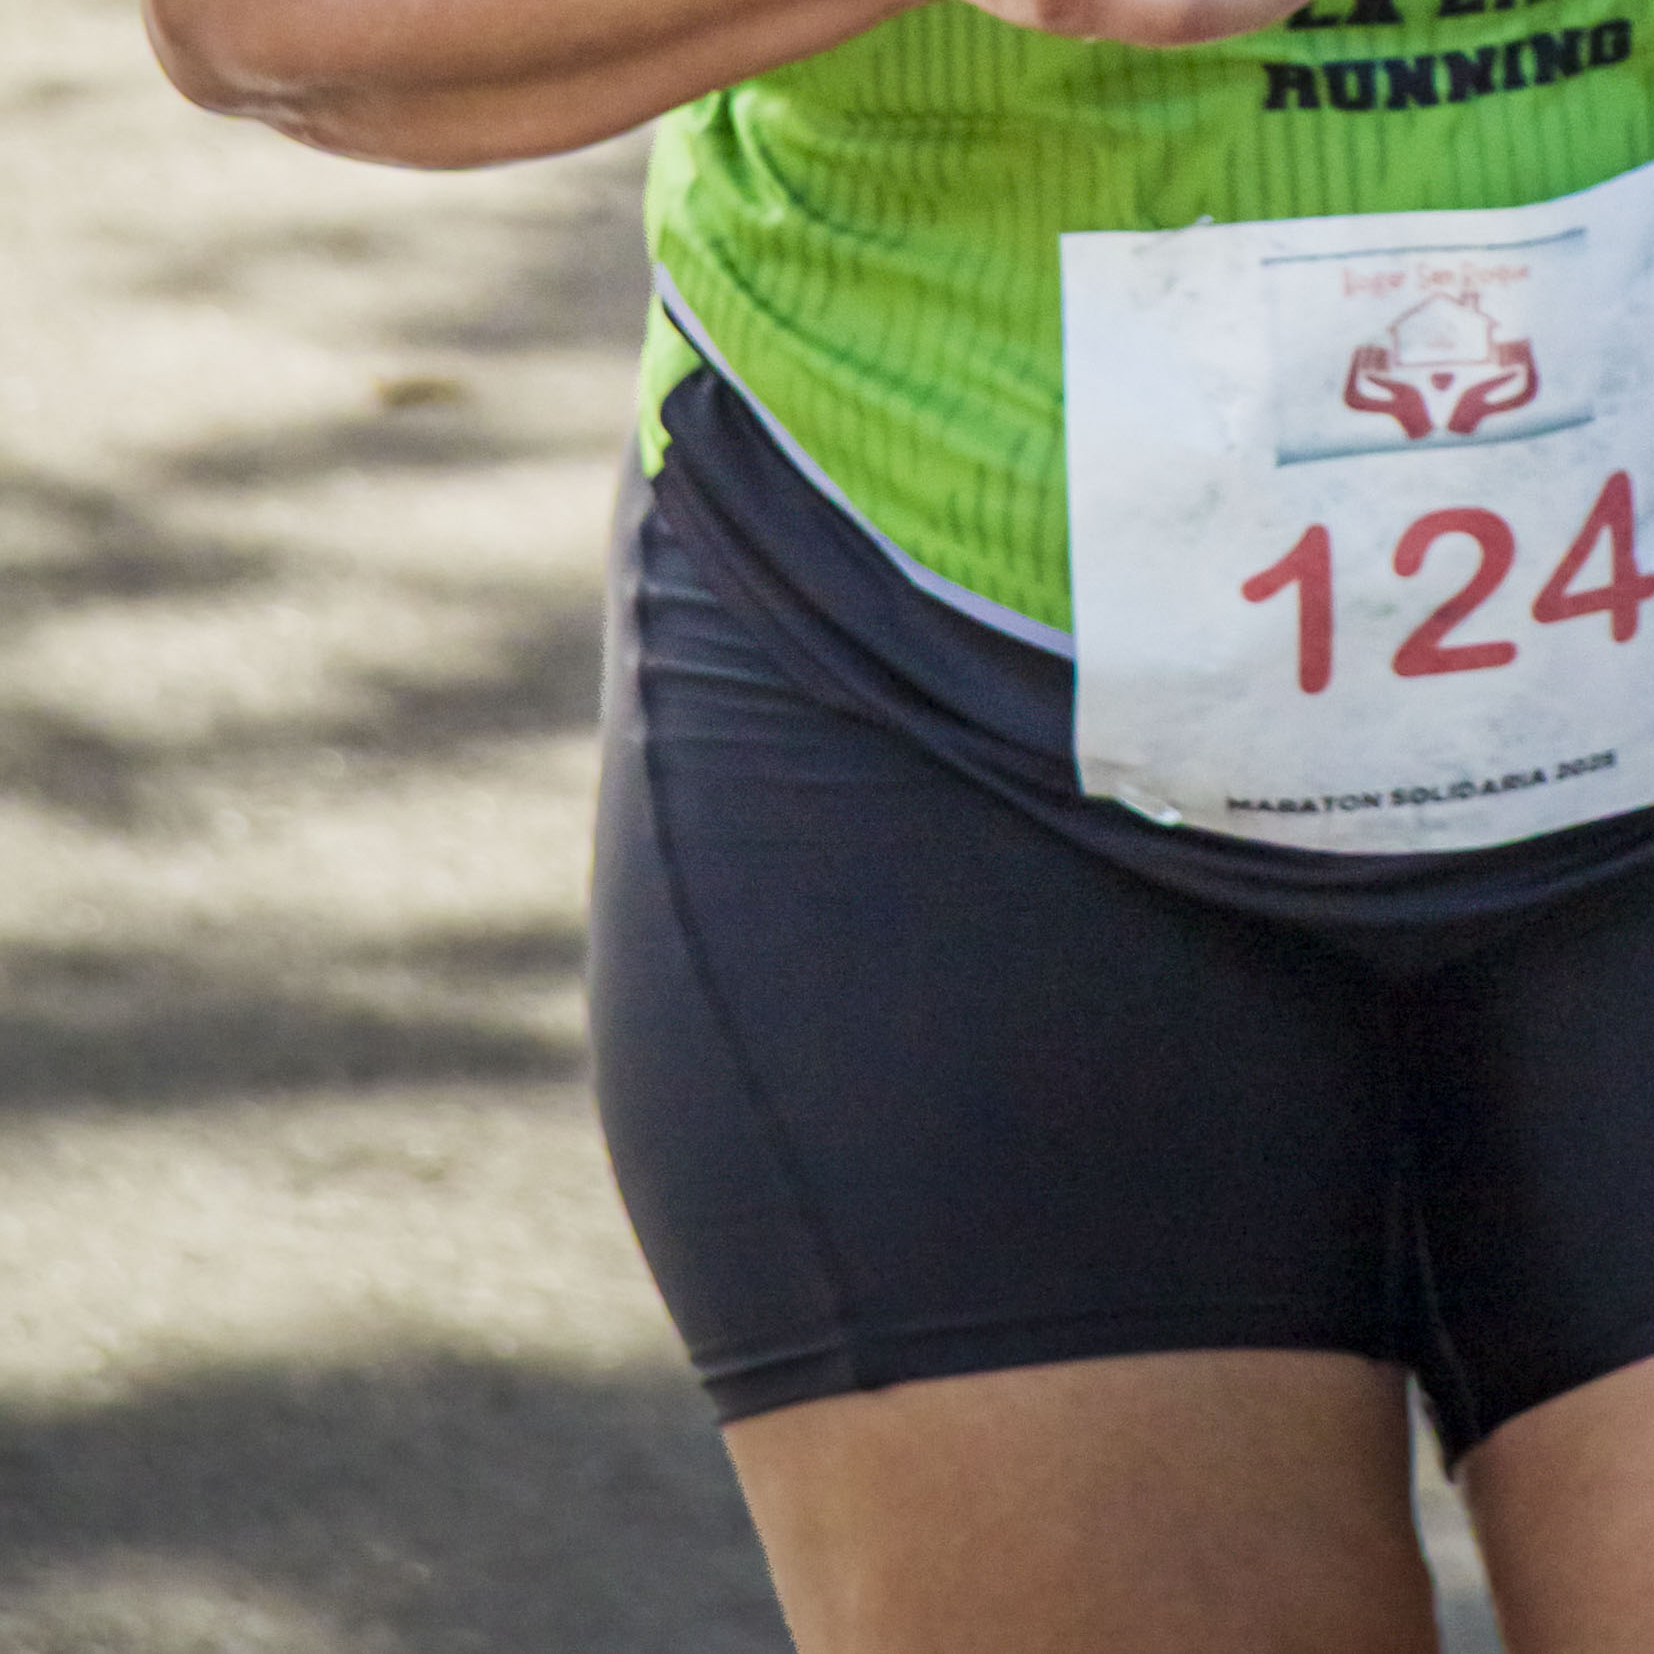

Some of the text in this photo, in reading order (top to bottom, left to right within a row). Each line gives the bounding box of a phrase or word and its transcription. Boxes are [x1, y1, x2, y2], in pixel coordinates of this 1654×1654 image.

[1263, 18, 1631, 111] RUNNING
[1226, 792, 1382, 813] MARATON
[1391, 767, 1546, 806] SOLIDARIA
